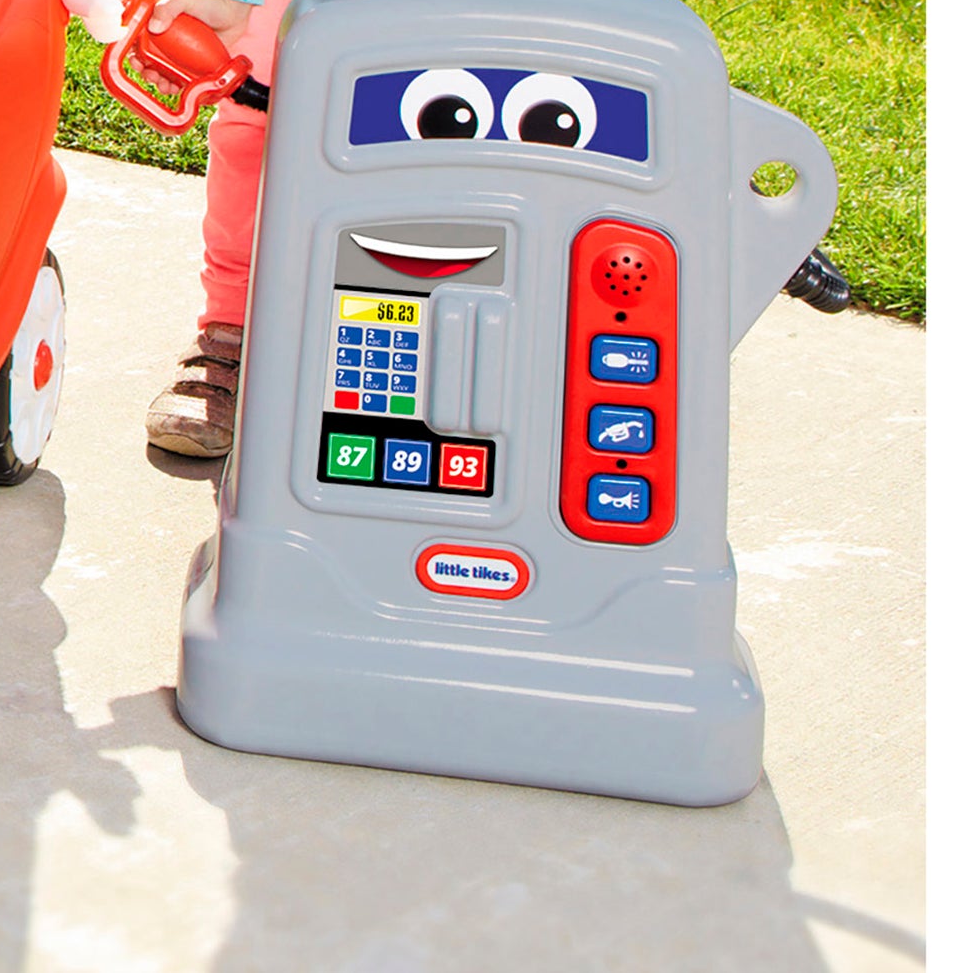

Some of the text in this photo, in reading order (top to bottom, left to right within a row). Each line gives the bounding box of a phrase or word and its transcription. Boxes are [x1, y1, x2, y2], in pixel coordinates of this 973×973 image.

[377, 302, 414, 322] $6.23
[340, 328, 403, 341] 1 2 3
[338, 349, 402, 363] 4 5 6
[338, 371, 401, 385] 7 8 9
[364, 395, 371, 404] 0
[336, 445, 478, 477] 87 89 93
[435, 561, 510, 582] little tikes
